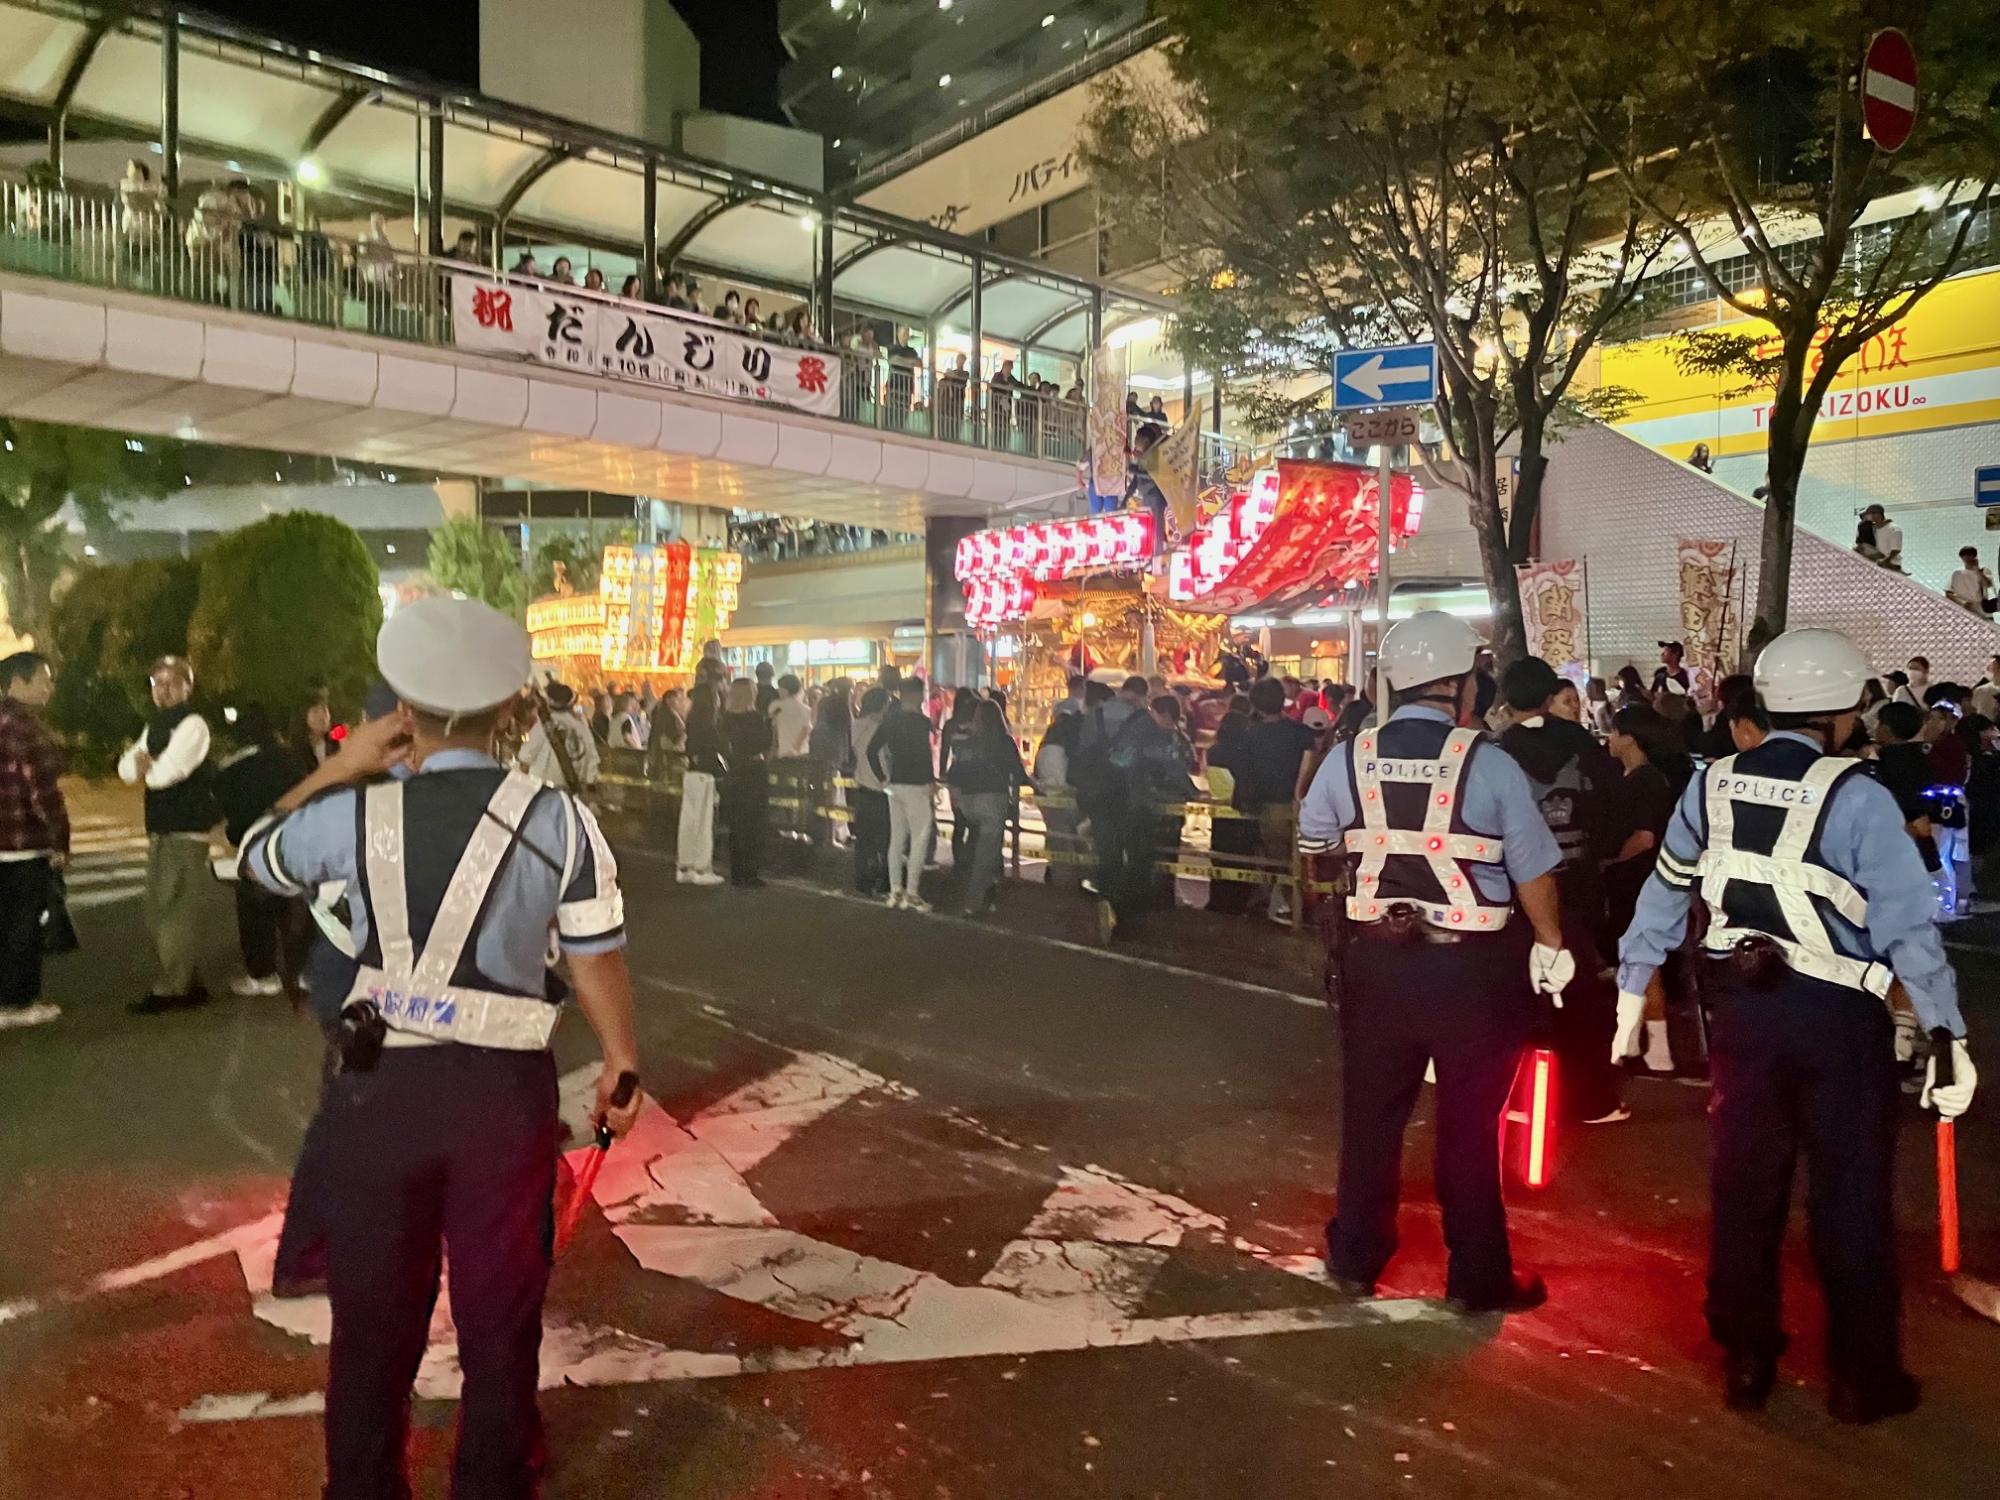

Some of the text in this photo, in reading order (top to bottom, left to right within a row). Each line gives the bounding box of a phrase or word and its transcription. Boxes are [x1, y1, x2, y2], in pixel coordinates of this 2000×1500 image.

[1352, 417, 1416, 440] ここから
[1366, 762, 1449, 779] POLICE
[1717, 779, 1815, 805] POLICE
